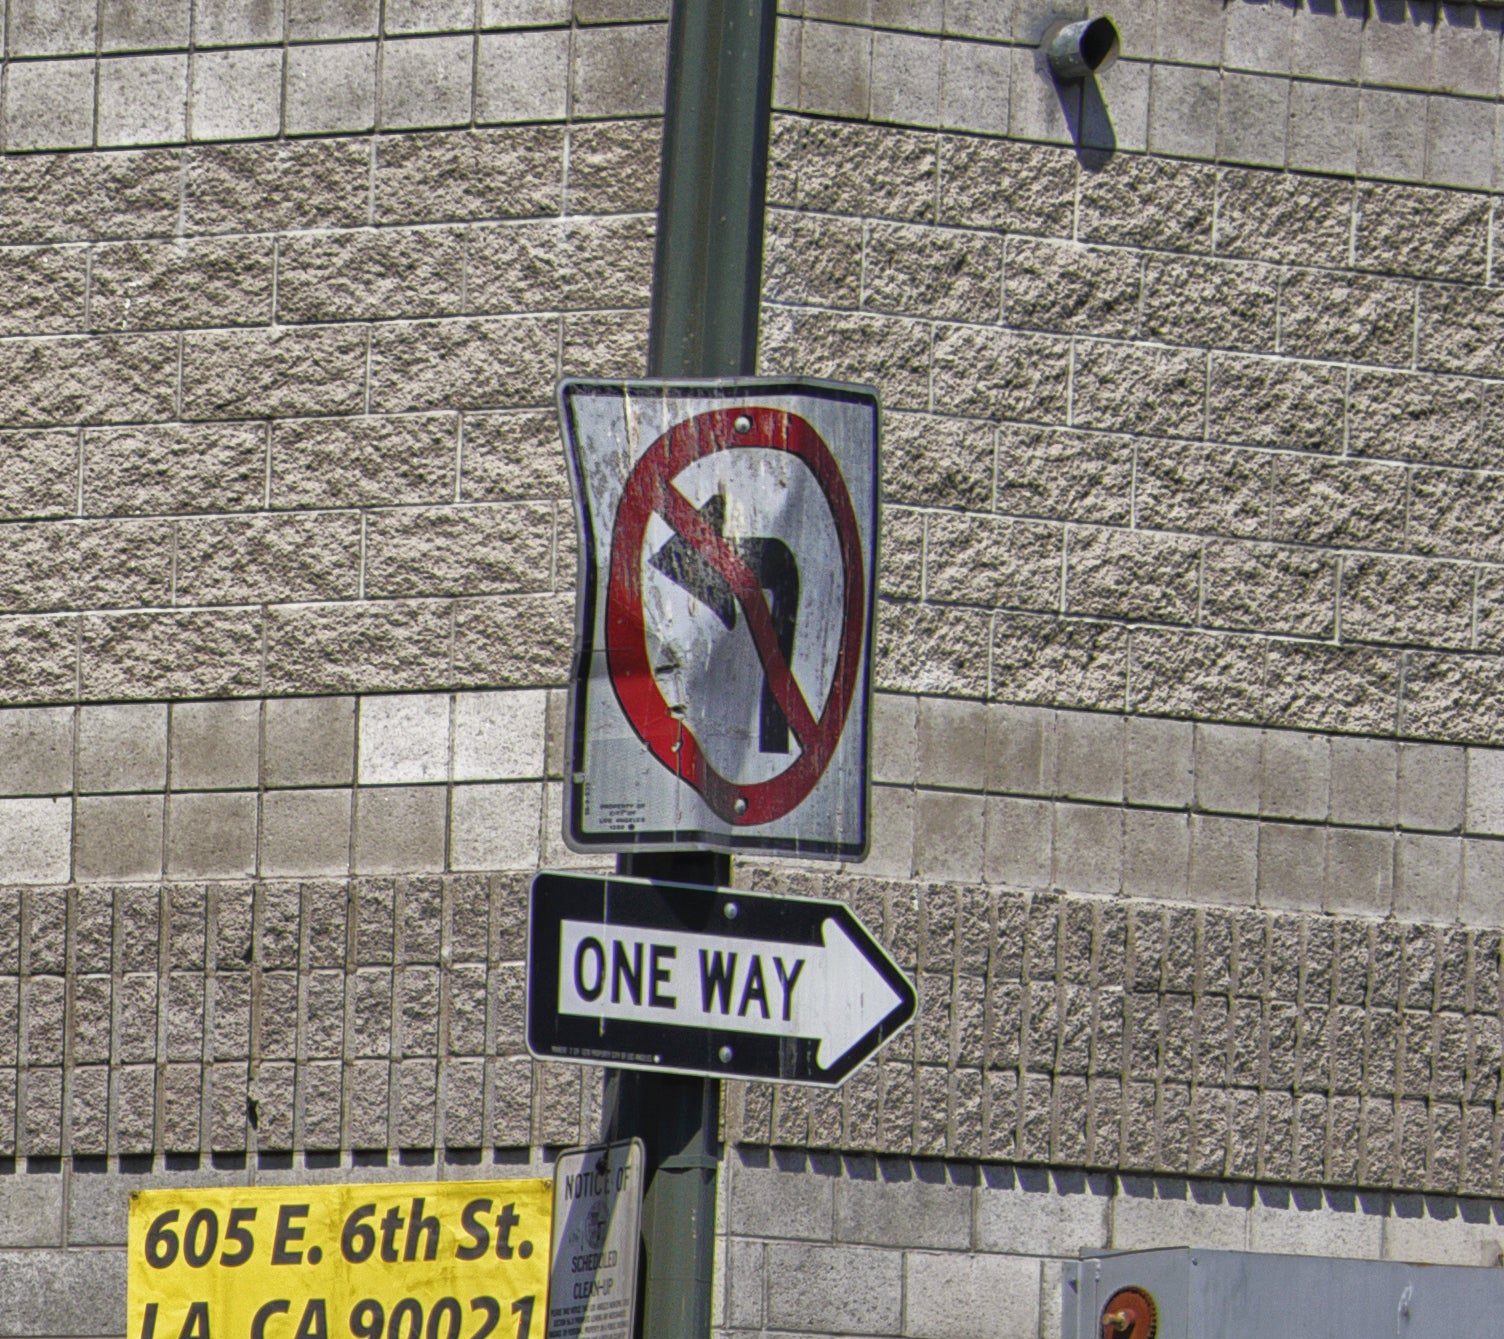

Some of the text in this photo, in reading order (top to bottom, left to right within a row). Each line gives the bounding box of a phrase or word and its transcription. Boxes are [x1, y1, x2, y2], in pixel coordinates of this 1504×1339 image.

[574, 936, 806, 1022] ONE WAY
[565, 1166, 632, 1200] NOTICE OF
[144, 1198, 536, 1269] 605 E. 6th St.
